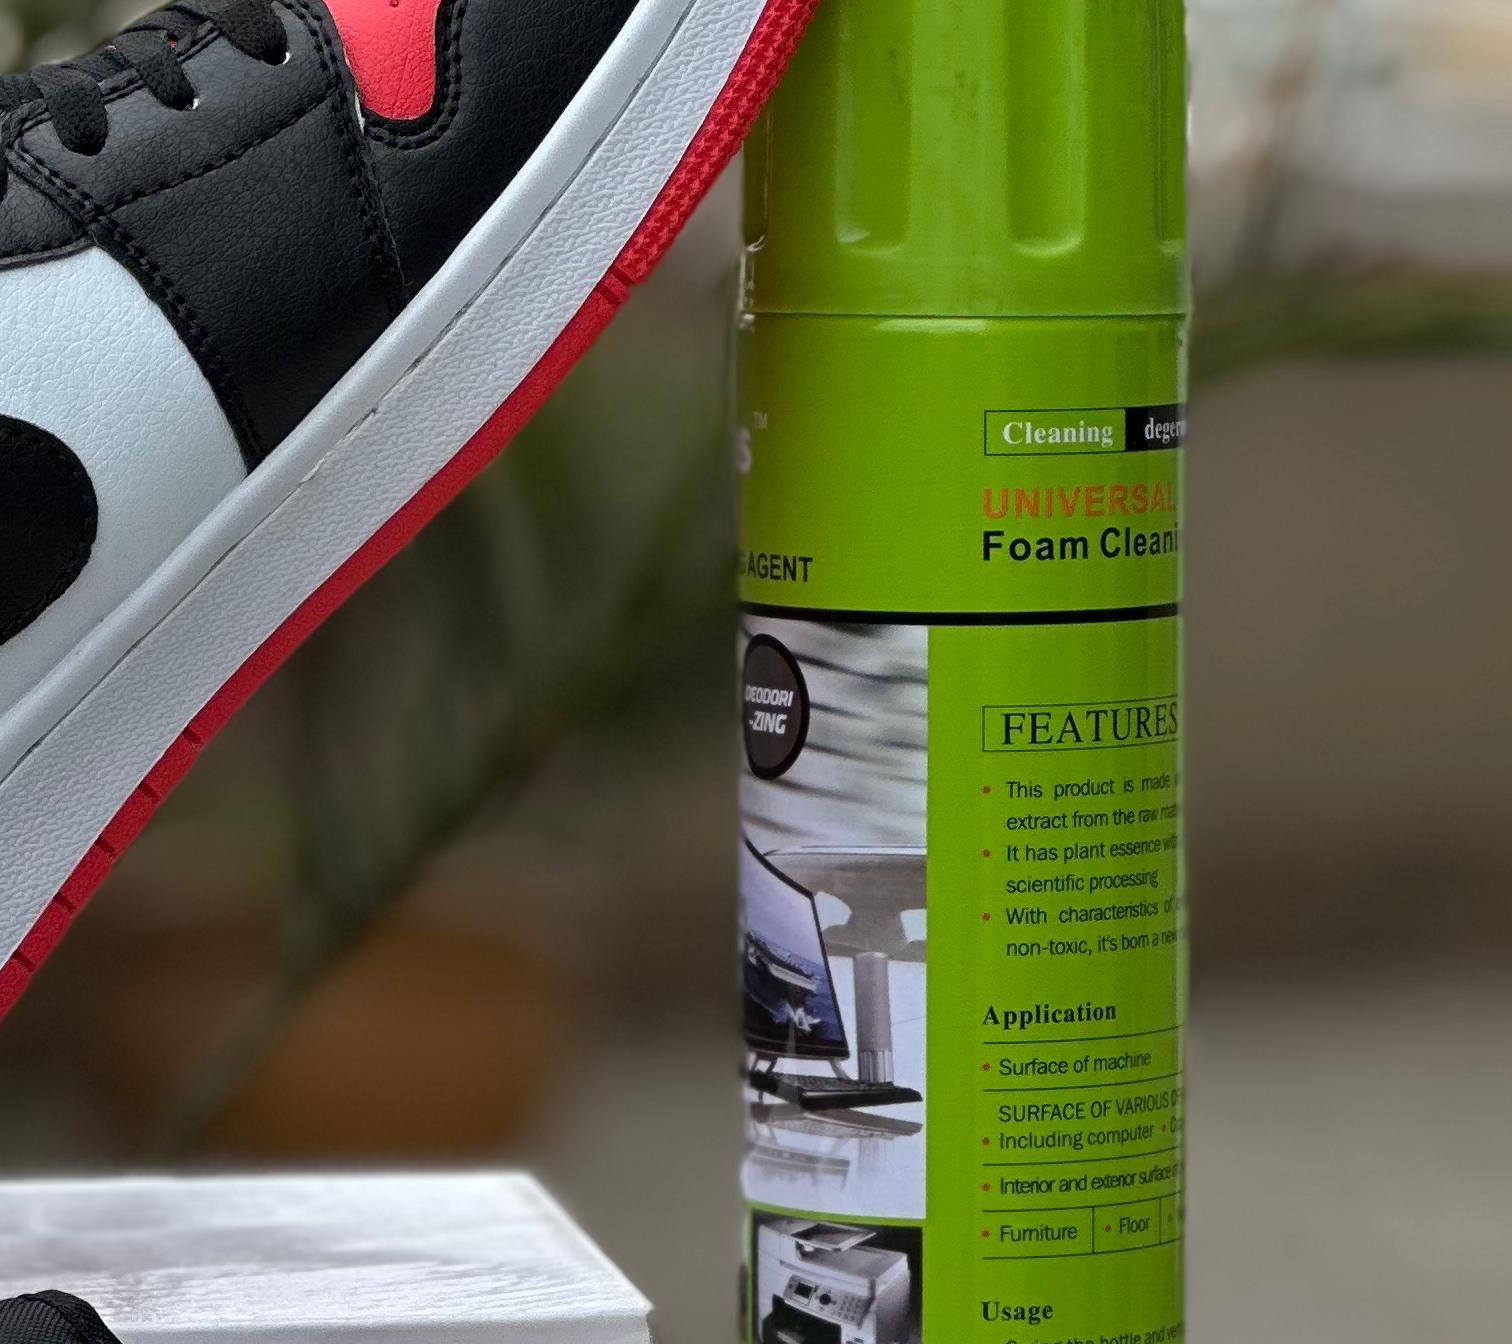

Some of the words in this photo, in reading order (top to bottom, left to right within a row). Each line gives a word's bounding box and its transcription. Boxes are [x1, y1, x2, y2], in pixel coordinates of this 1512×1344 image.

[1002, 420, 1113, 447] Cleaning
[983, 481, 1177, 520] UNIVERSAL
[983, 530, 1088, 561] Foam
[747, 552, 813, 582] AGENT
[1002, 702, 1178, 746] FEATURES
[1006, 780, 1043, 799] This
[1054, 777, 1115, 801] product
[1123, 775, 1135, 793] is
[1006, 812, 1067, 830] extract
[1072, 810, 1109, 828] from
[1112, 809, 1135, 825] the
[1006, 844, 1019, 862] It
[1025, 844, 1058, 862] has
[1064, 842, 1105, 864] plant
[1110, 837, 1160, 857] essence
[1006, 874, 1085, 893] scientific
[1090, 869, 1159, 894] processing
[1006, 907, 1047, 926] With
[1058, 899, 1159, 924] characteristics
[1006, 938, 1093, 956] non-toxic,
[983, 1002, 1117, 1030] Application
[999, 1057, 1068, 1076] Surface
[1073, 1055, 1090, 1073] of
[1093, 1052, 1152, 1072] machine
[999, 1102, 1086, 1123] SURFACE
[1090, 1100, 1112, 1118] OF
[1116, 1090, 1169, 1115] VARIOUS
[1000, 1131, 1083, 1150] Including
[1088, 1124, 1154, 1147] computer
[1000, 1177, 1055, 1194] Interior
[1059, 1174, 1087, 1192] and
[1091, 1171, 1137, 1190] exterior
[1000, 1225, 1077, 1242] Furniture
[1119, 1216, 1150, 1235] Floor
[981, 1301, 1053, 1325] Usage
[1144, 1326, 1164, 1344] and
